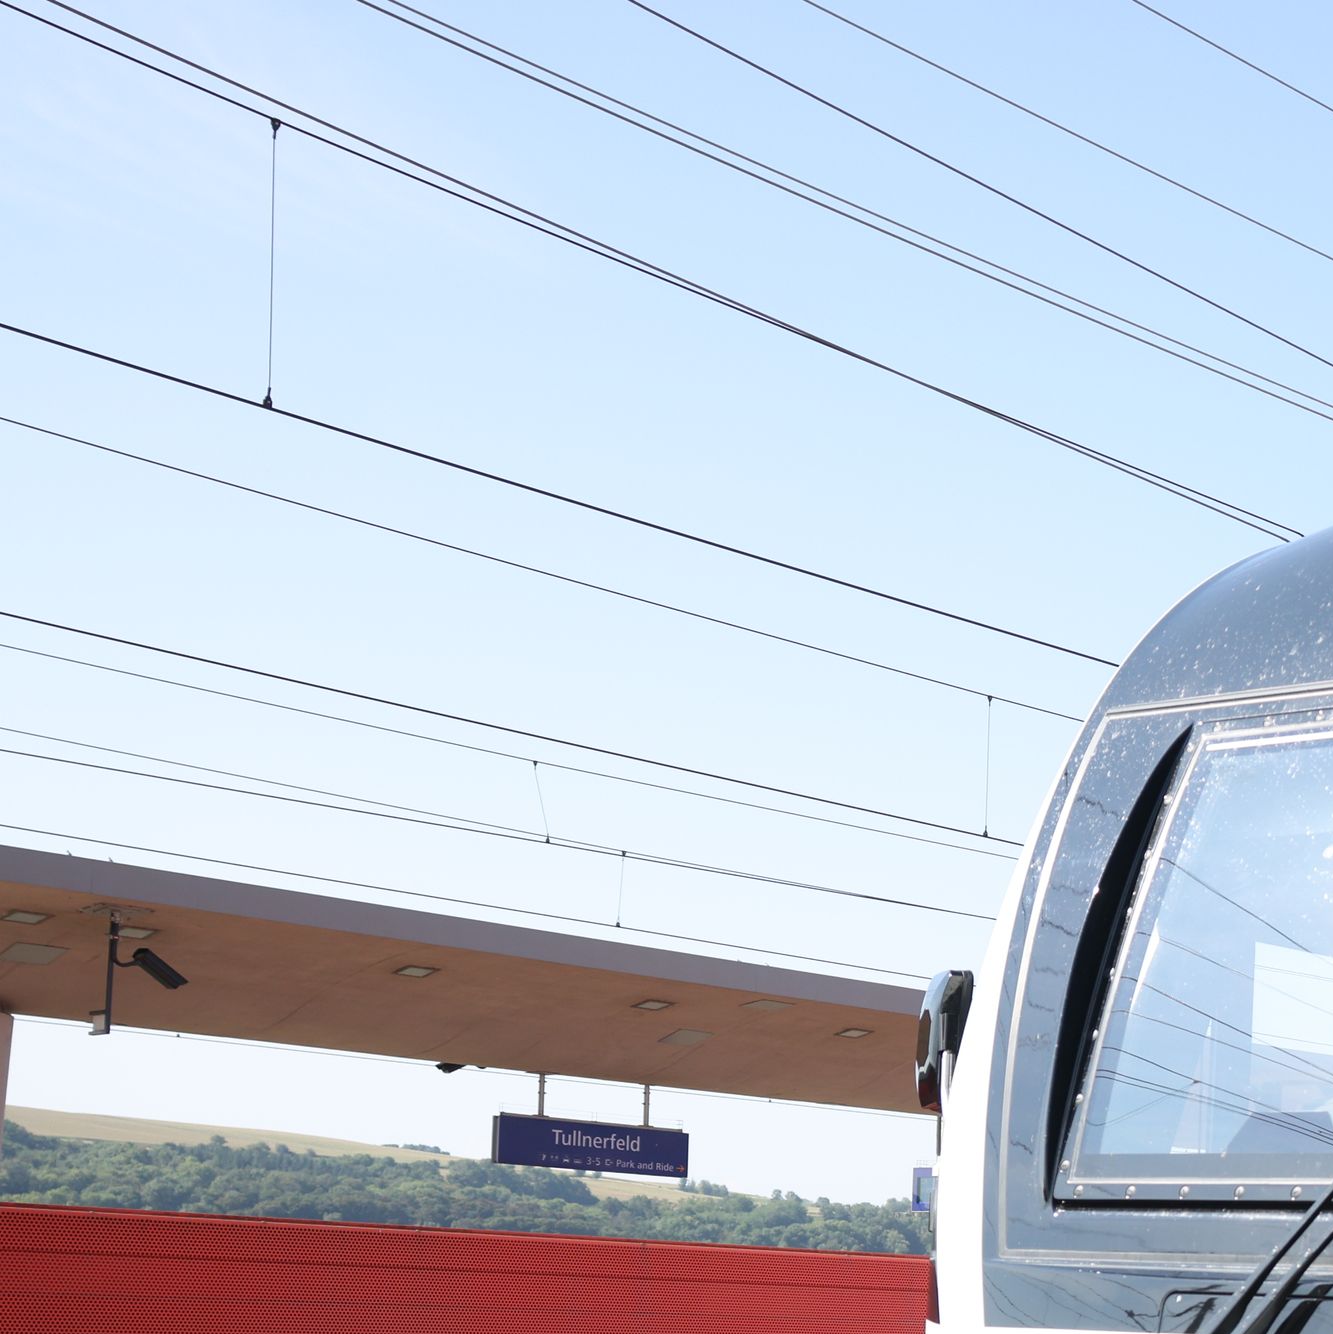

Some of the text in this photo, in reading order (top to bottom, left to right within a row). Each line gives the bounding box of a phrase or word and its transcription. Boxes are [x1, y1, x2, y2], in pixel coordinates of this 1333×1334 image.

[552, 1129, 641, 1152] Tullnerfeld
[616, 1159, 635, 1169] Park
[637, 1161, 653, 1170] and
[655, 1162, 674, 1172] Ride
